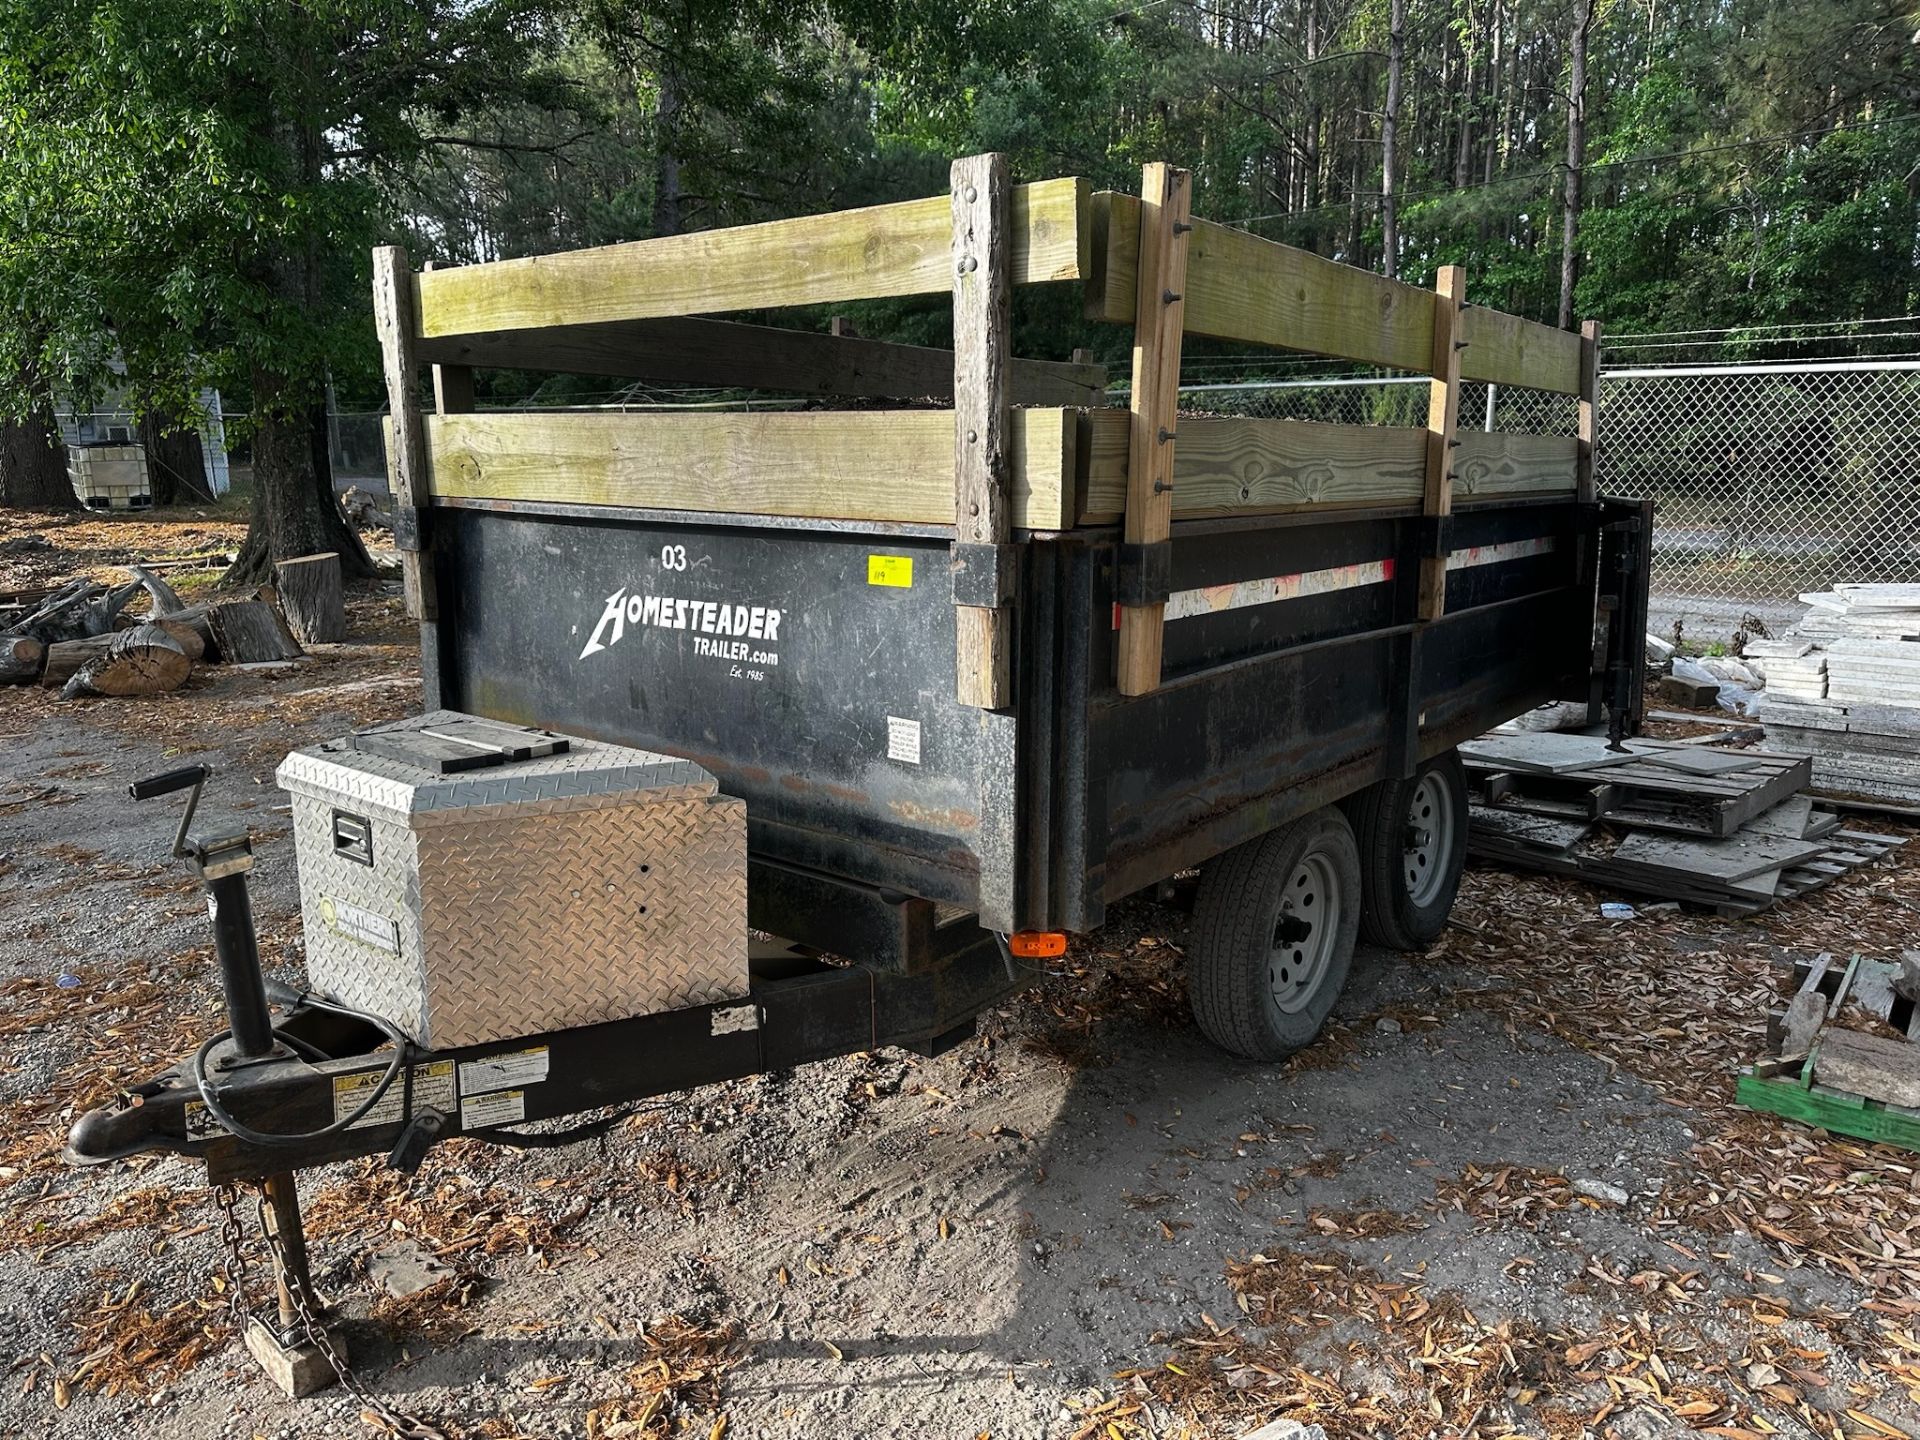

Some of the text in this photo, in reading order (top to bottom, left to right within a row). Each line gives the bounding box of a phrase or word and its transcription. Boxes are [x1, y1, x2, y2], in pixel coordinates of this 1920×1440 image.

[661, 545, 687, 571] 03
[579, 587, 781, 660] HOMESTEADER
[694, 637, 779, 666] TRAILER.com
[746, 669, 765, 681] 1985
